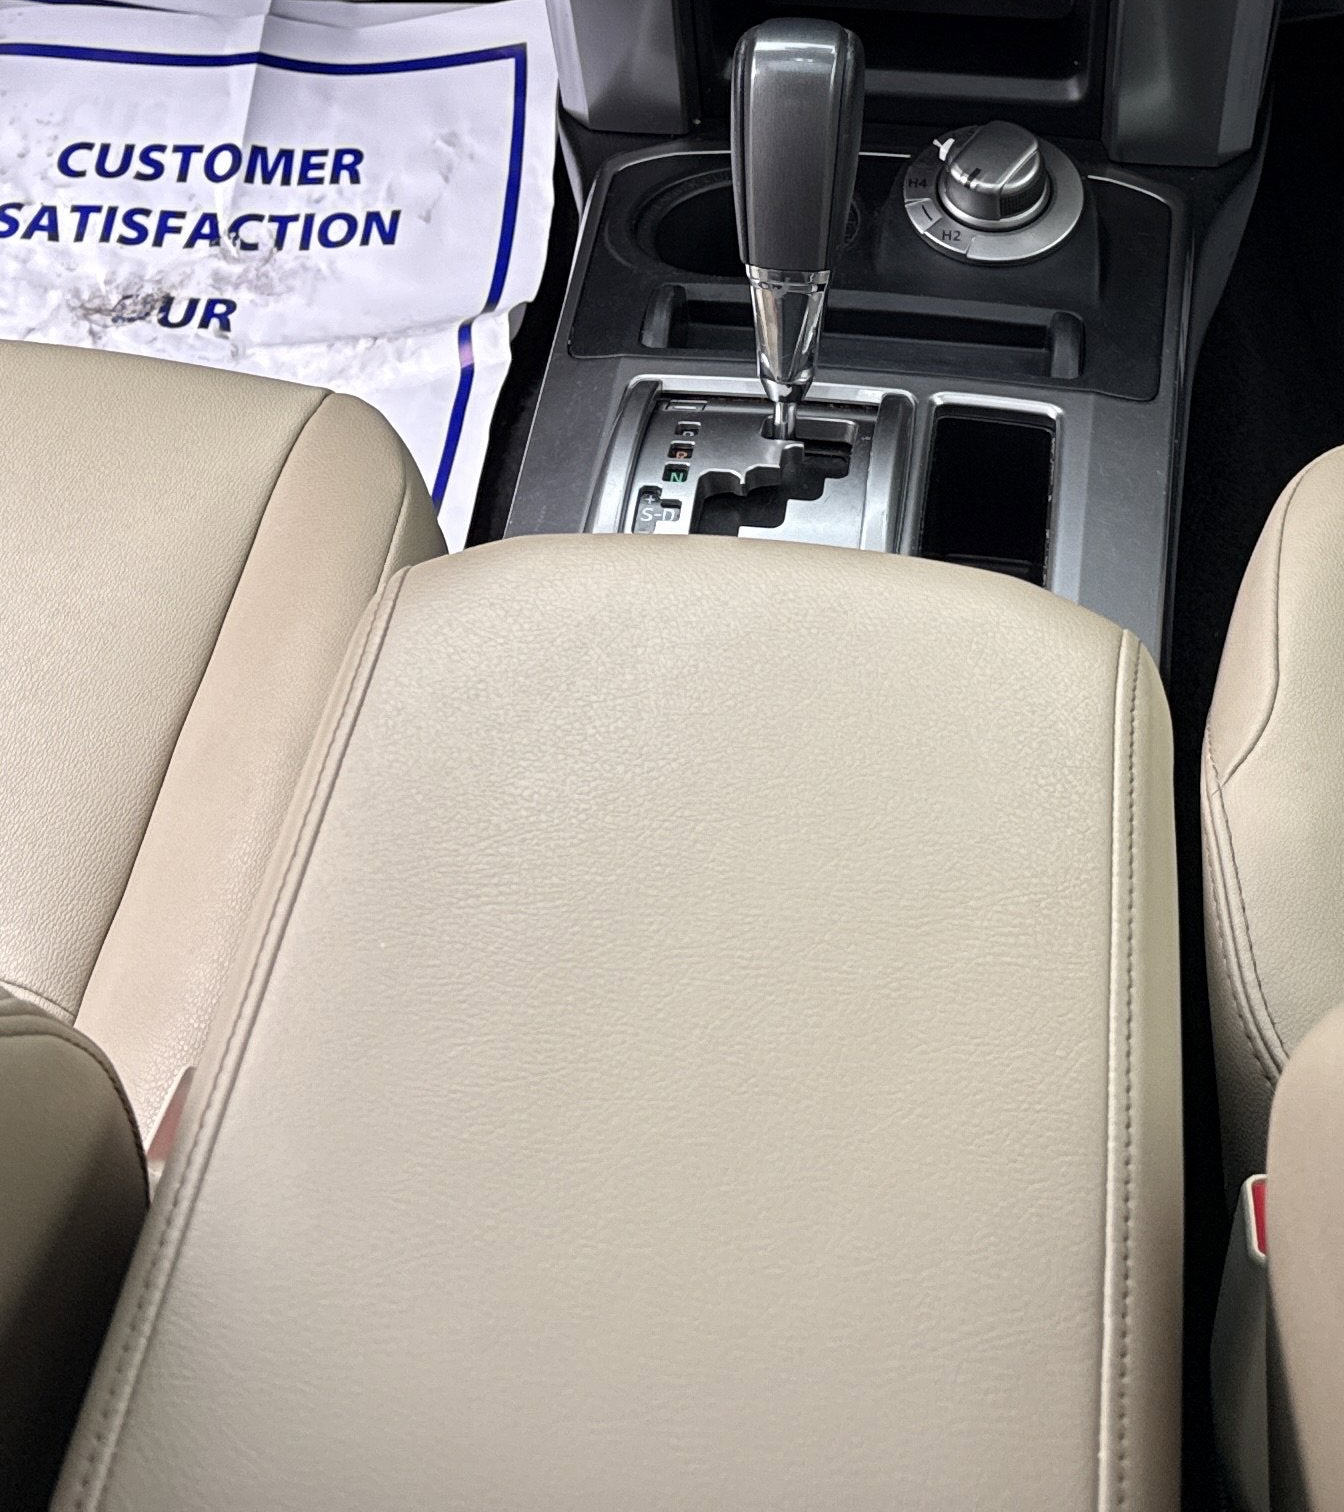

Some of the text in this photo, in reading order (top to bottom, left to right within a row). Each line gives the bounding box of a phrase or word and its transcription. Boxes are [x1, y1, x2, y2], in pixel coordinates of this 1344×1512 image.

[56, 140, 365, 188] CUSTOMER
[942, 230, 962, 242] H2
[670, 472, 684, 483] N
